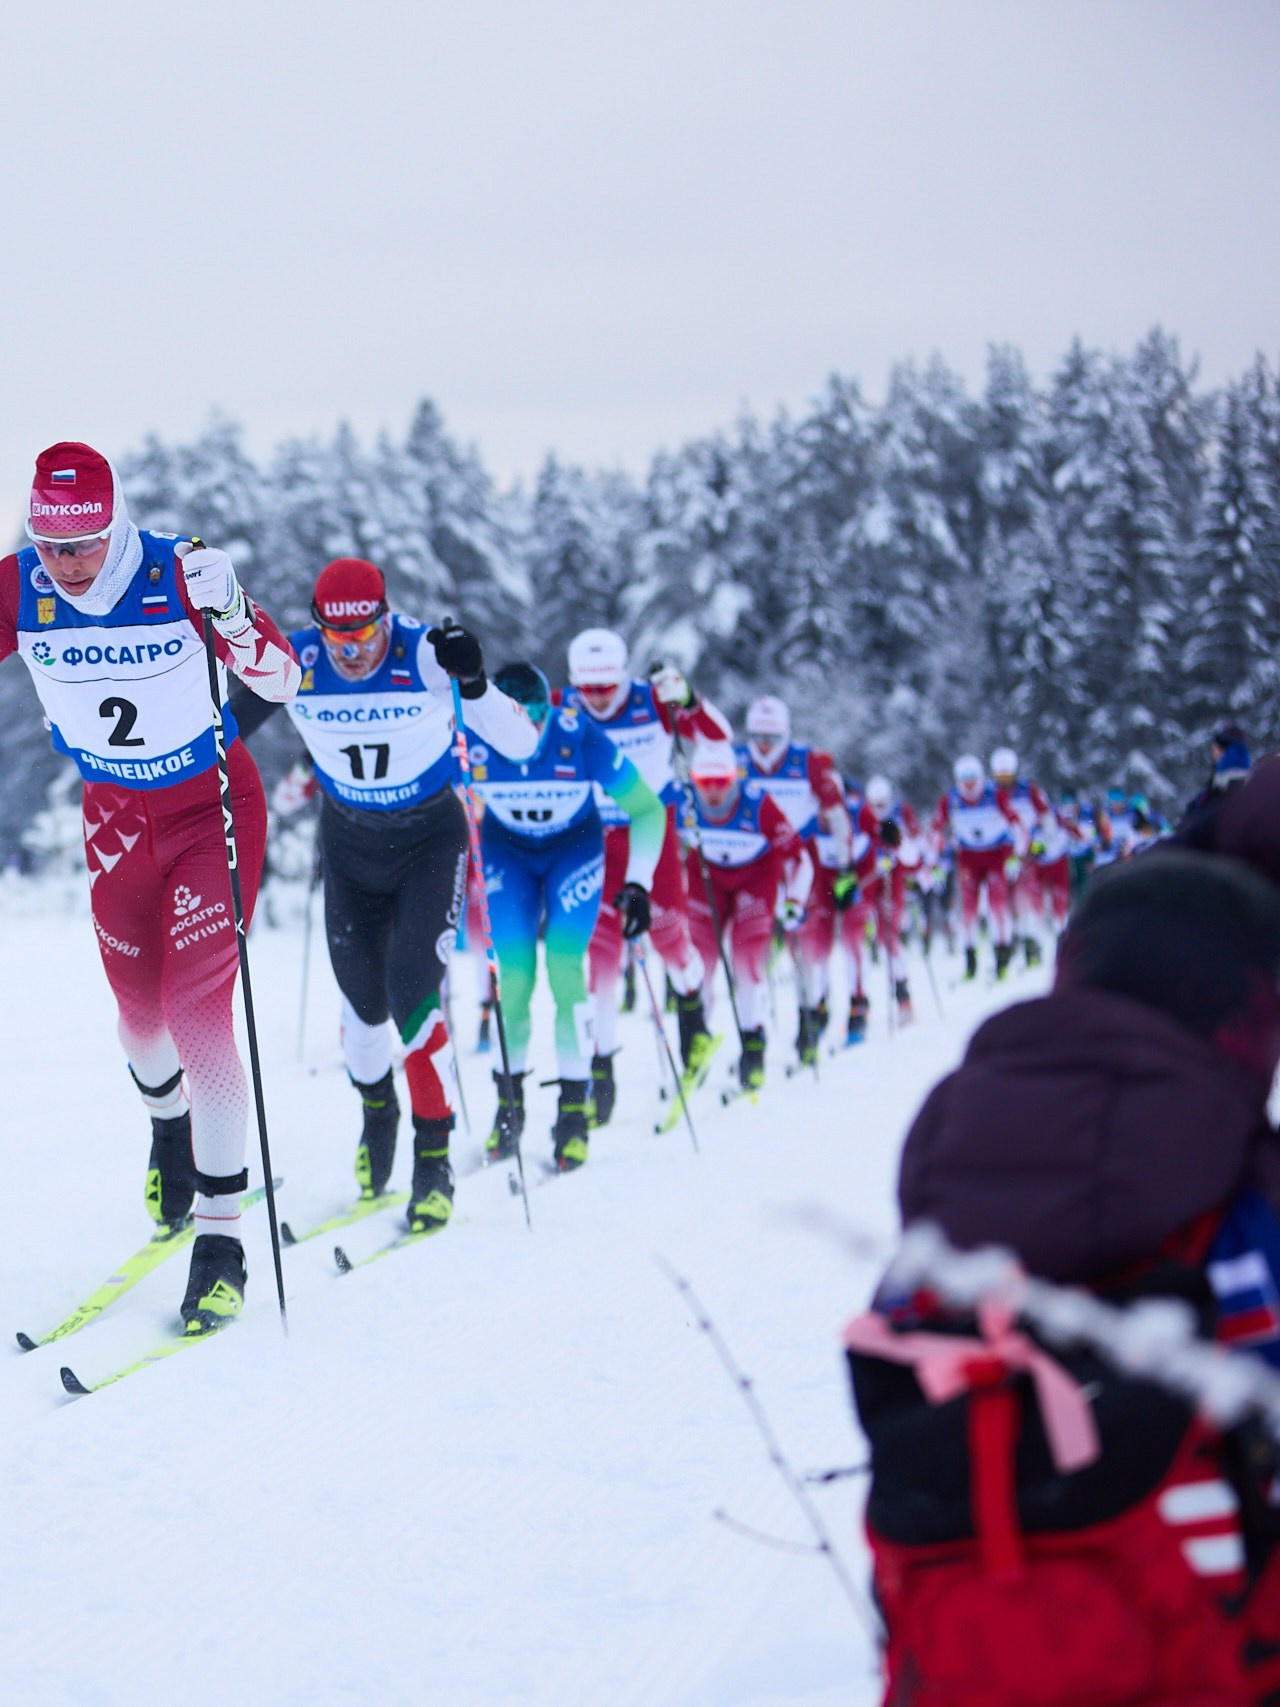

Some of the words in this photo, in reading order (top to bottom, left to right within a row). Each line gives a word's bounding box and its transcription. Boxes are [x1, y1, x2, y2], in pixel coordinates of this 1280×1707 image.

[40, 501, 103, 516] ЛУКОЙЛ
[62, 639, 183, 666] ФОСАГРО
[99, 697, 145, 747] 2
[317, 706, 422, 723] ФОСАГРО
[81, 747, 195, 781] ЧЕПЕЦКОЕ
[339, 743, 390, 780] 17
[175, 917, 230, 950] BIVIUM
